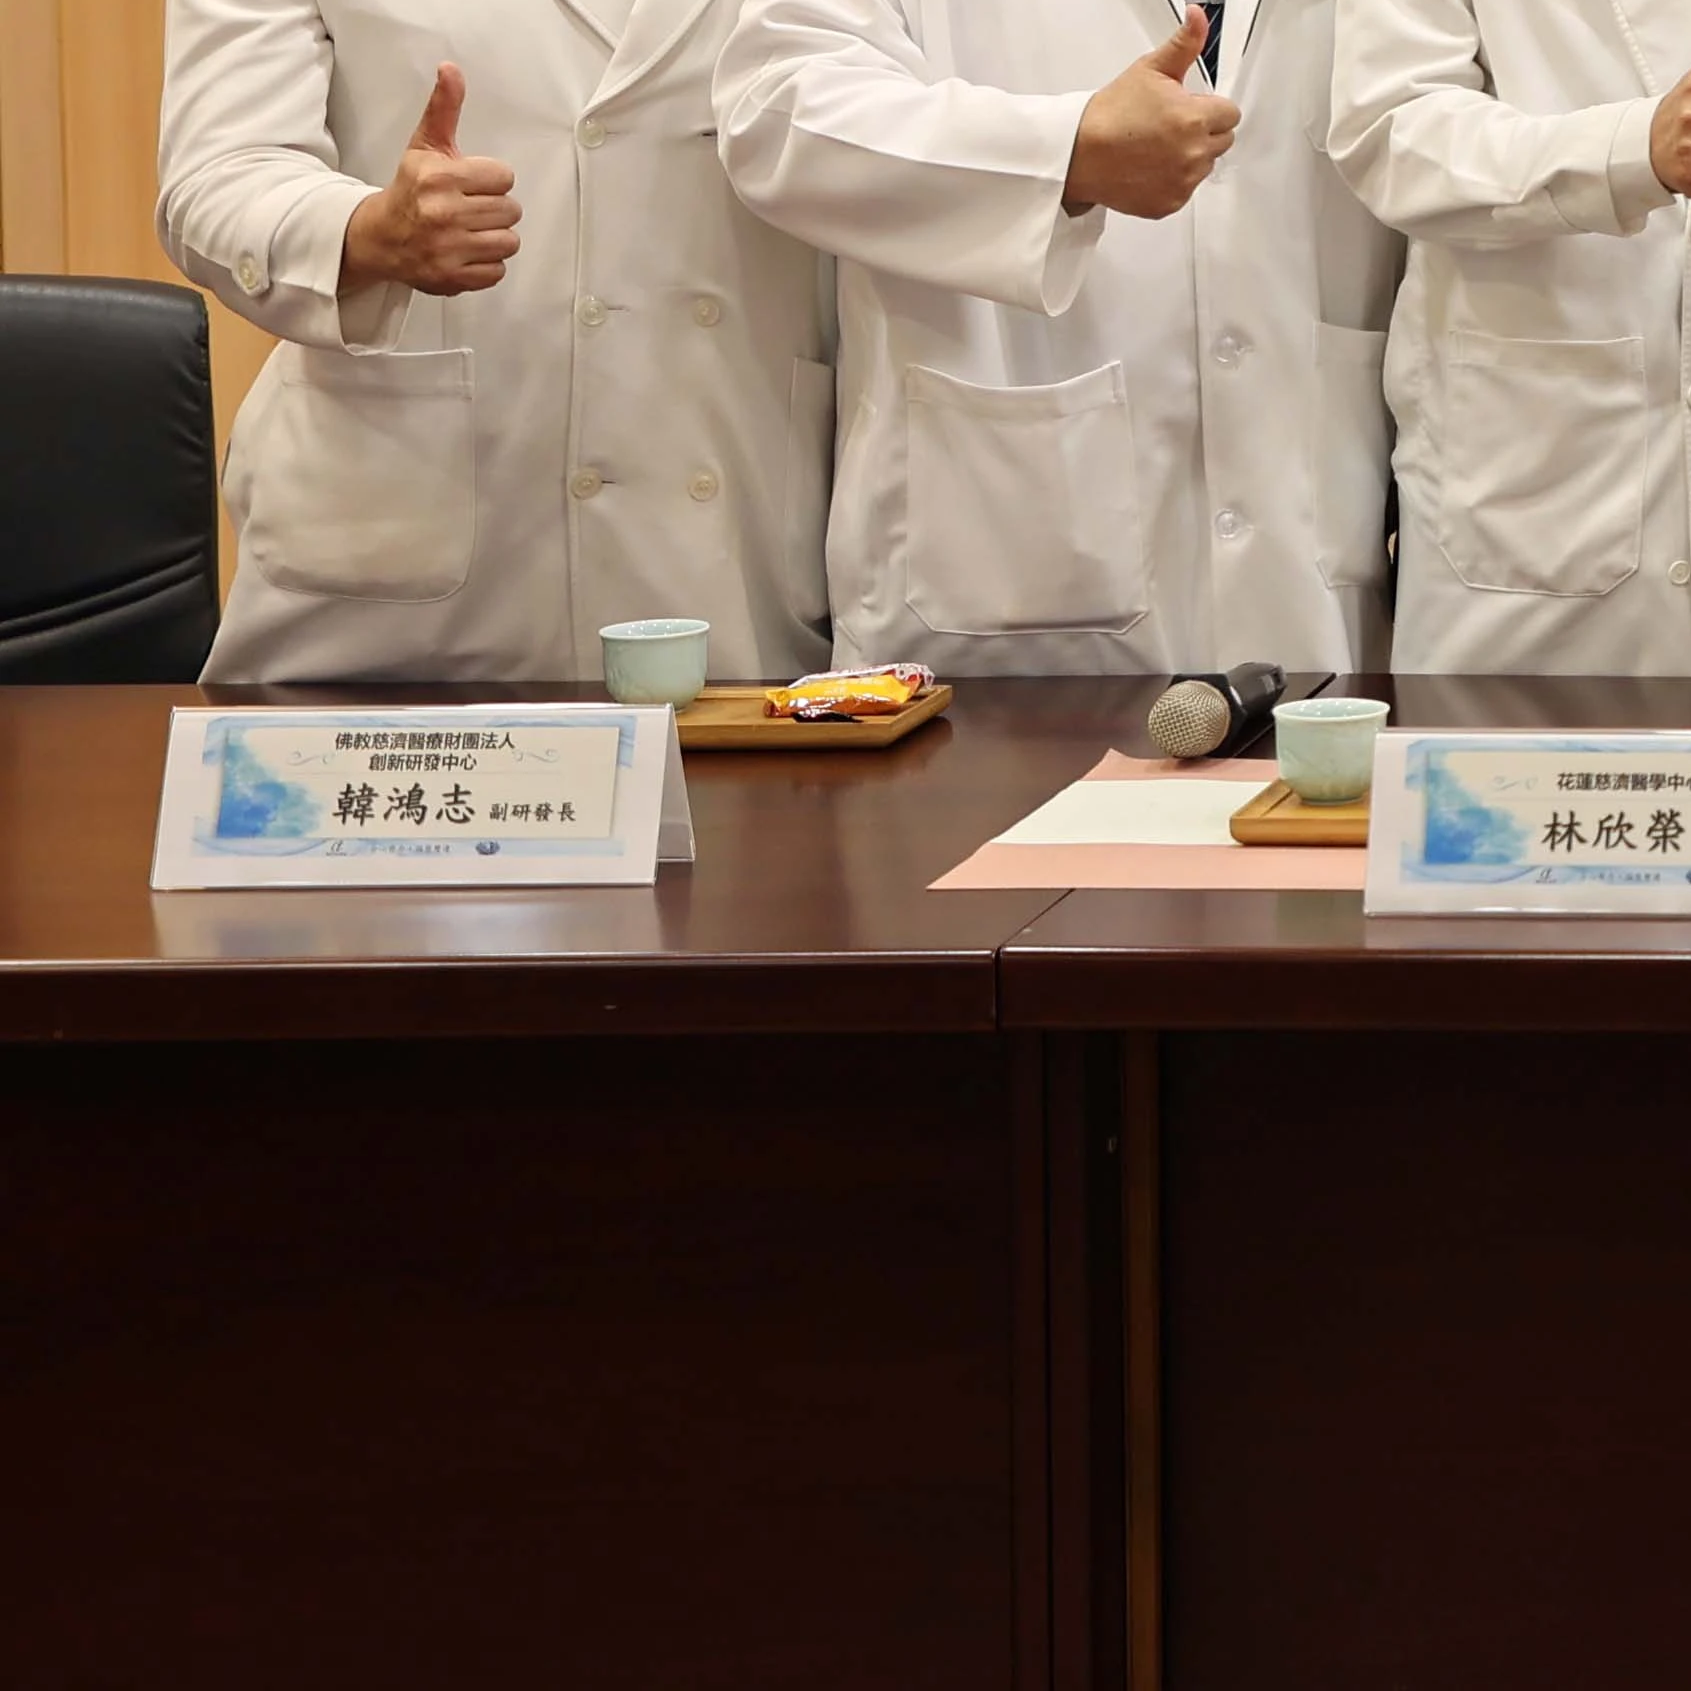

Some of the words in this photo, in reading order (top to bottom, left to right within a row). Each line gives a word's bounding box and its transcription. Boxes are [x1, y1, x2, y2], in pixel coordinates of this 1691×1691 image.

[334, 730, 516, 751] 佛教慈濟醫療財團法人
[367, 752, 478, 773] 創新研發中心
[331, 781, 477, 828] 韓鴻志
[488, 801, 577, 823] 副研發長
[1540, 807, 1686, 854] 林欣榮
